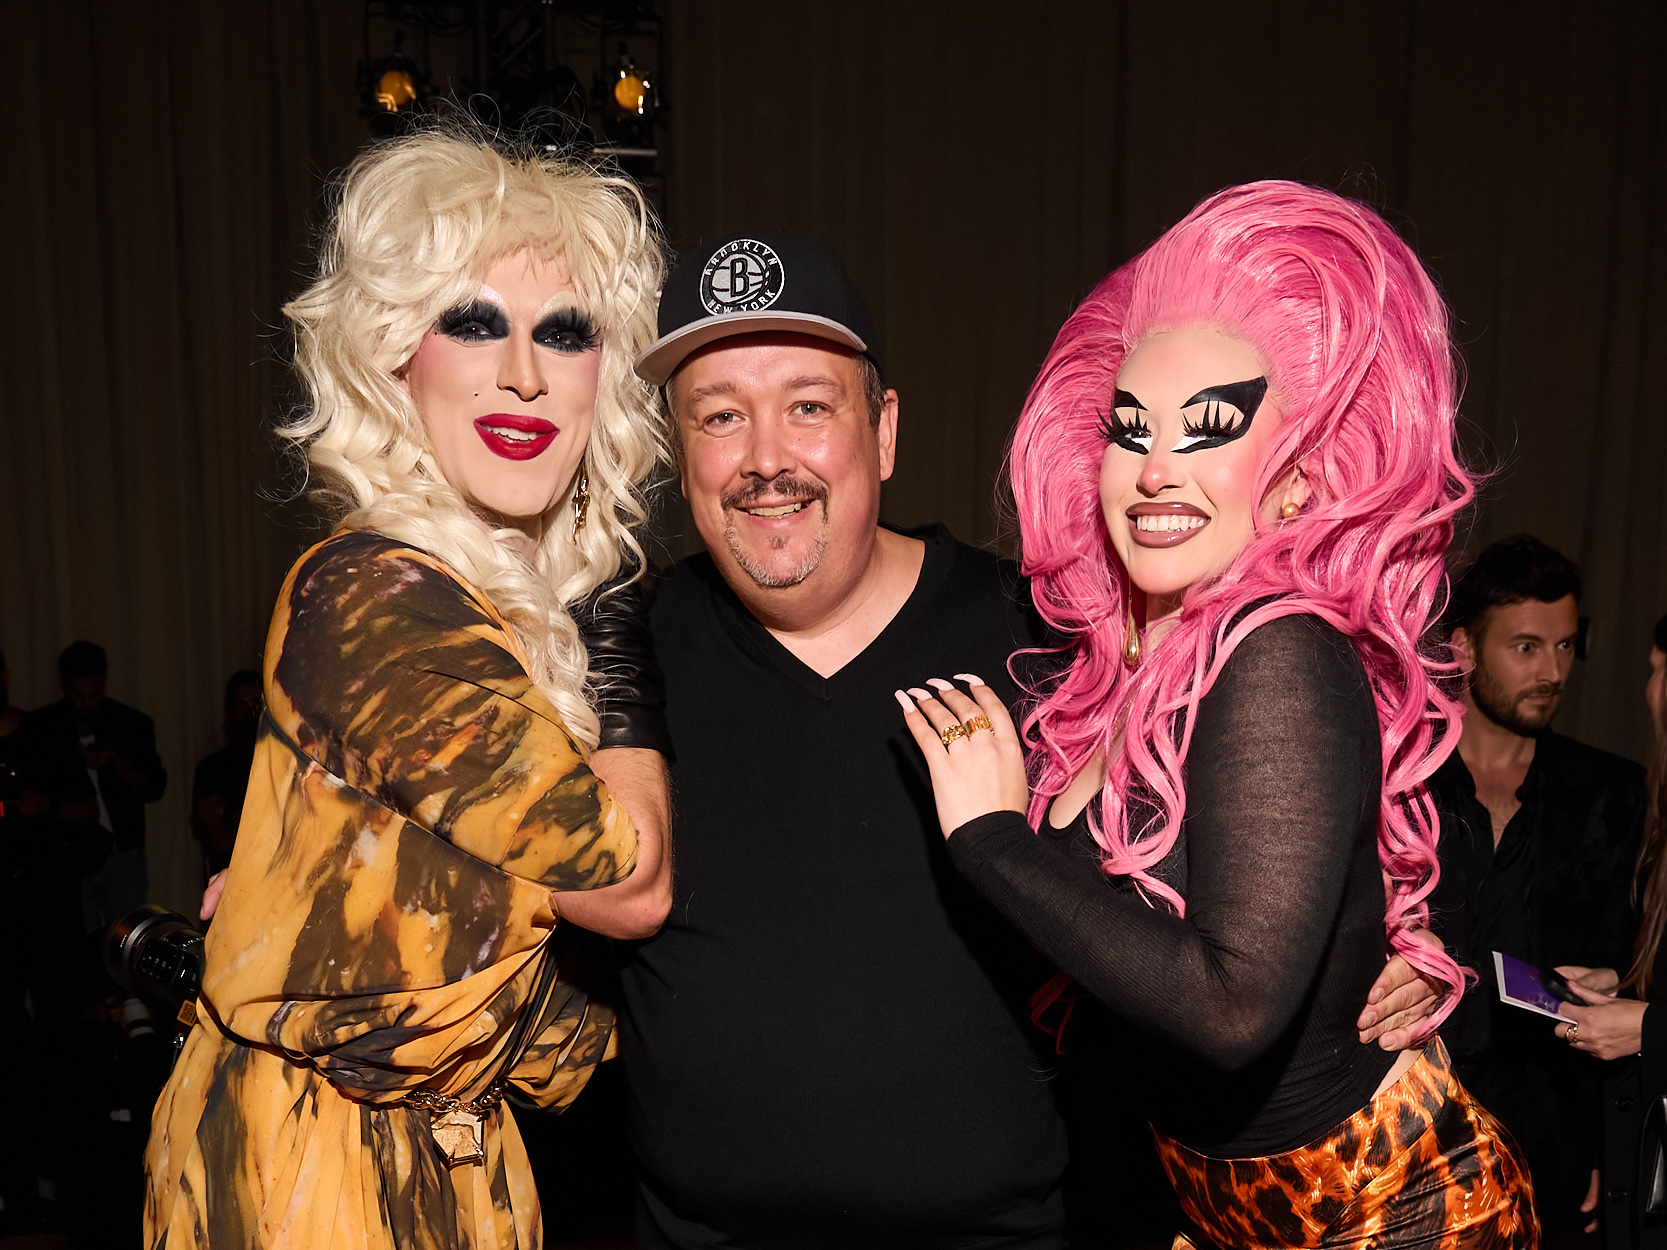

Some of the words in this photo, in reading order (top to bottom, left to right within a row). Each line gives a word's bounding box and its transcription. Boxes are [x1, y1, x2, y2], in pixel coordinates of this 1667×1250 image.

[704, 241, 778, 276] BROOKLYN
[729, 257, 750, 298] B
[707, 299, 734, 314] NEW
[741, 289, 776, 312] YORK
